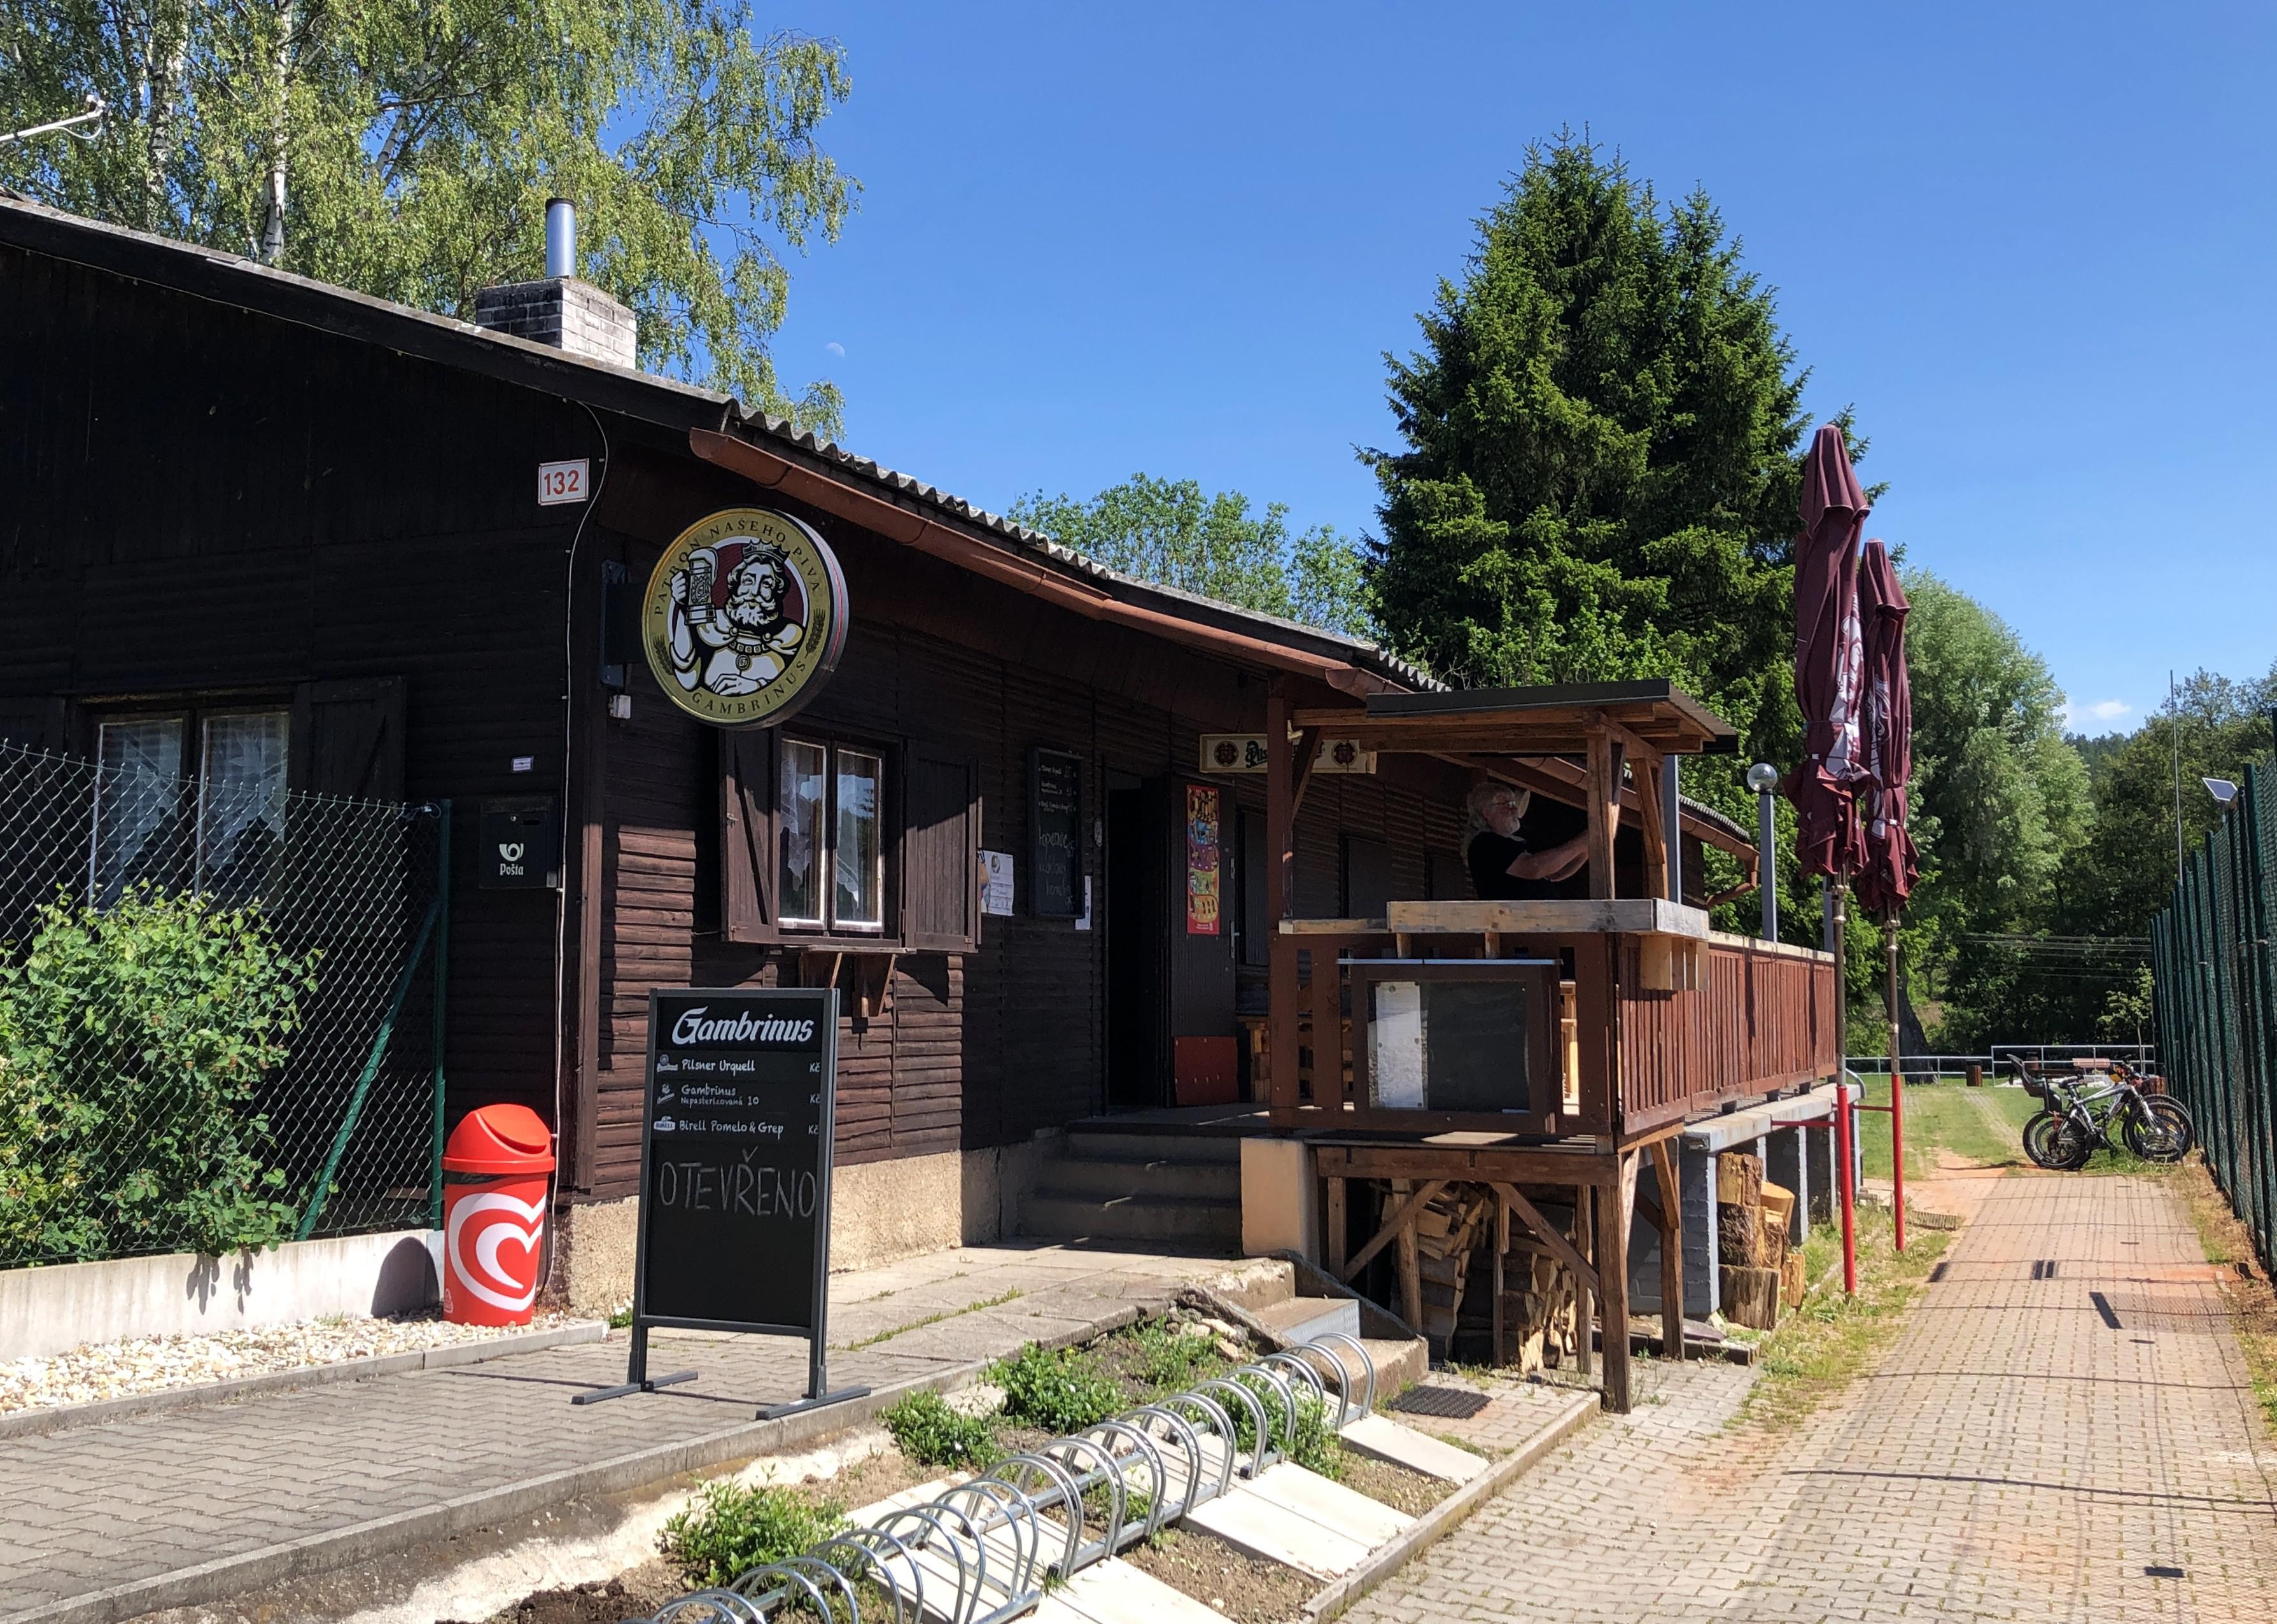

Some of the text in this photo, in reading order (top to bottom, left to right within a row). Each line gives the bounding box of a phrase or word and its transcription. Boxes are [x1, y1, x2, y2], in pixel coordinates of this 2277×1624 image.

[543, 469, 579, 496] 132
[654, 518, 821, 615] PATRON NAŠEHO PIVA
[692, 661, 806, 715] GAMBRINUS
[500, 863, 524, 876] Pošta
[671, 1005, 815, 1045] Gambrinus
[682, 1058, 716, 1072] Pilsner
[719, 1059, 756, 1077] Urquell
[681, 1082, 736, 1096] Gambrinus
[747, 1096, 760, 1105] 10
[678, 1119, 706, 1131] Birell
[711, 1120, 748, 1132] Pomelo
[757, 1121, 784, 1140] Grep
[659, 1145, 817, 1221] OTEVŘENO
